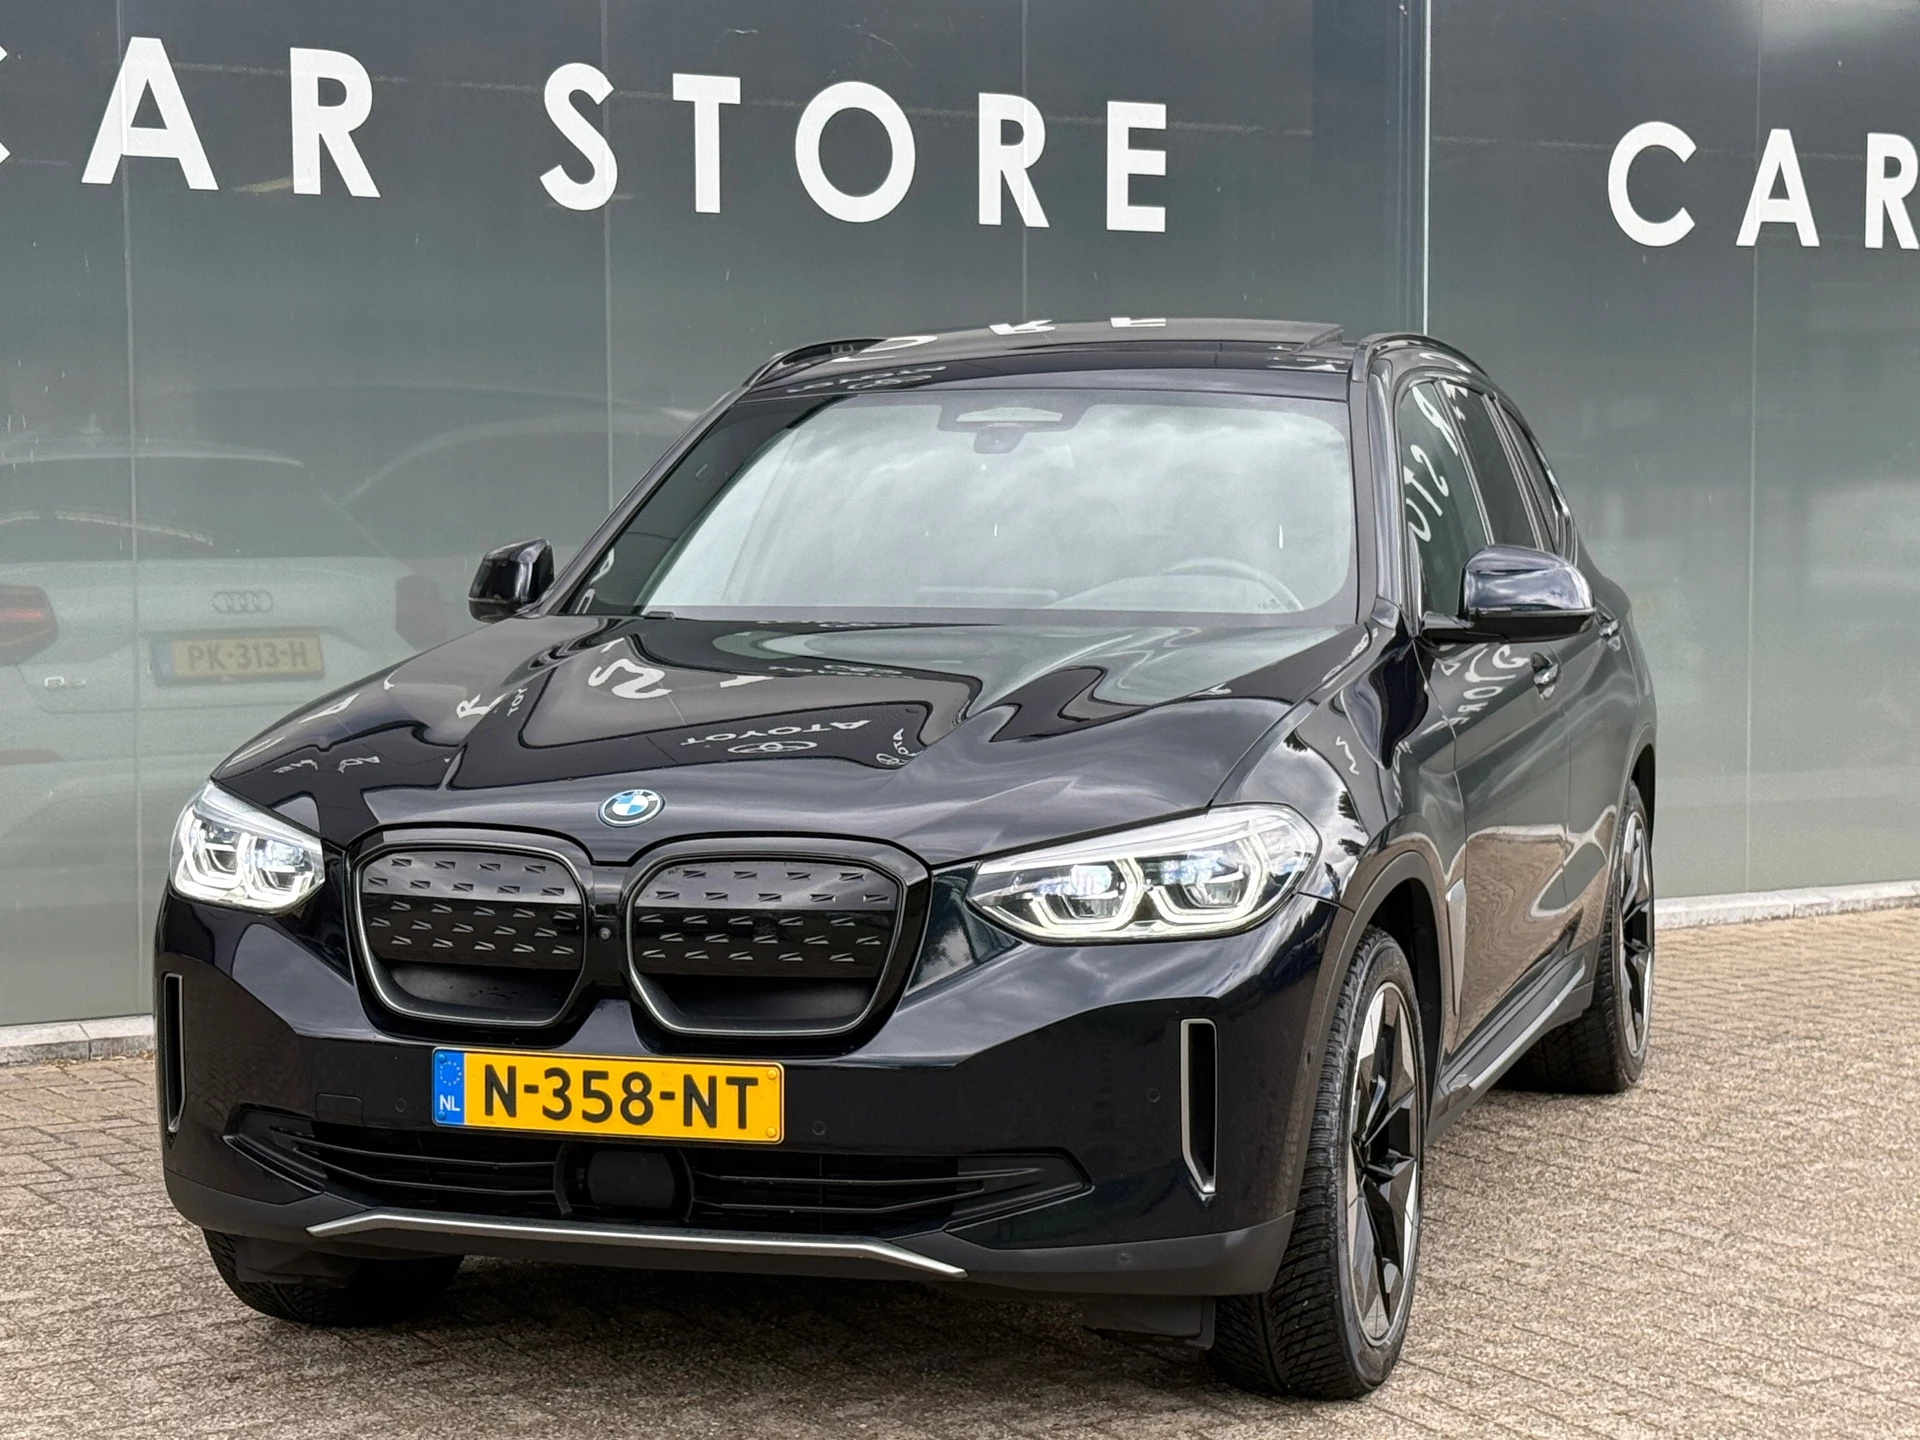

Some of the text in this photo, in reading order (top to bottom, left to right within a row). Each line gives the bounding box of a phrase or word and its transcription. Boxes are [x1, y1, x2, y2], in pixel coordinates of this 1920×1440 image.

[0, 37, 1167, 233] AR STORE
[1608, 122, 1920, 249] CAR
[187, 641, 308, 671] PK-313-H
[440, 1094, 461, 1112] NL
[484, 1064, 759, 1130] N-358-NT
